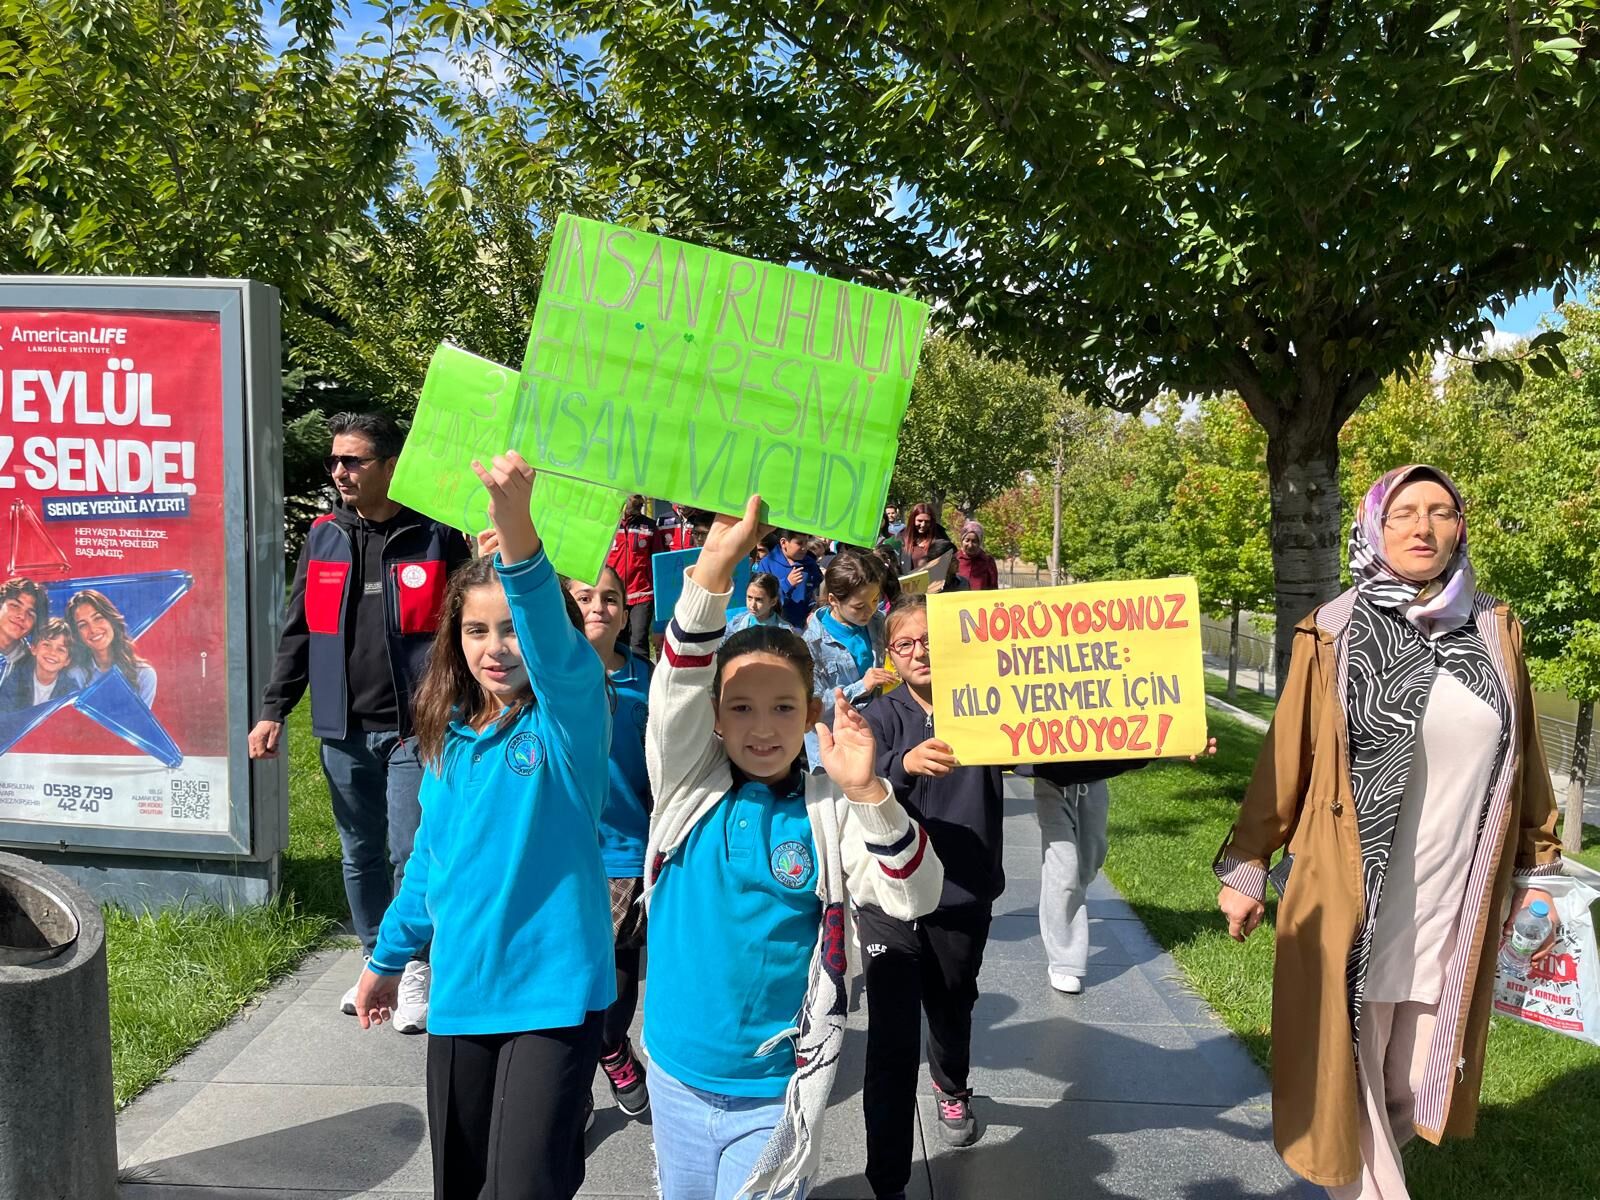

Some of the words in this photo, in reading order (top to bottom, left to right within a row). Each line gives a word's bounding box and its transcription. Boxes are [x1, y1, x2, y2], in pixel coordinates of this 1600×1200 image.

[716, 261, 928, 380] RUHUNUN
[69, 346, 110, 354] INSTITUTE
[11, 357, 171, 427] EYLÜL
[527, 300, 611, 391] EN
[618, 321, 695, 408] İYİ
[696, 340, 878, 454] RESMİ
[23, 436, 197, 496] SENDE!
[89, 496, 138, 515] YERİNİ
[139, 498, 186, 512] AYIRT!
[75, 528, 91, 536] HER
[92, 528, 118, 538] YAŞTA
[75, 538, 91, 546] HER
[92, 538, 118, 548] YAŞTA
[119, 538, 140, 548] YENİ
[141, 539, 159, 549] BİR
[959, 594, 1188, 643] NÖRÜYOSUNUZ
[952, 683, 1001, 717] KİLO
[1011, 678, 1113, 715] VERMEK
[1122, 671, 1181, 711] İÇİN
[1000, 714, 1174, 757] YÜRÜYOZ!
[43, 783, 82, 798] 0538
[84, 785, 113, 800] 799
[57, 798, 77, 811] 42
[79, 799, 99, 812] 40
[866, 943, 888, 954] NIKE
